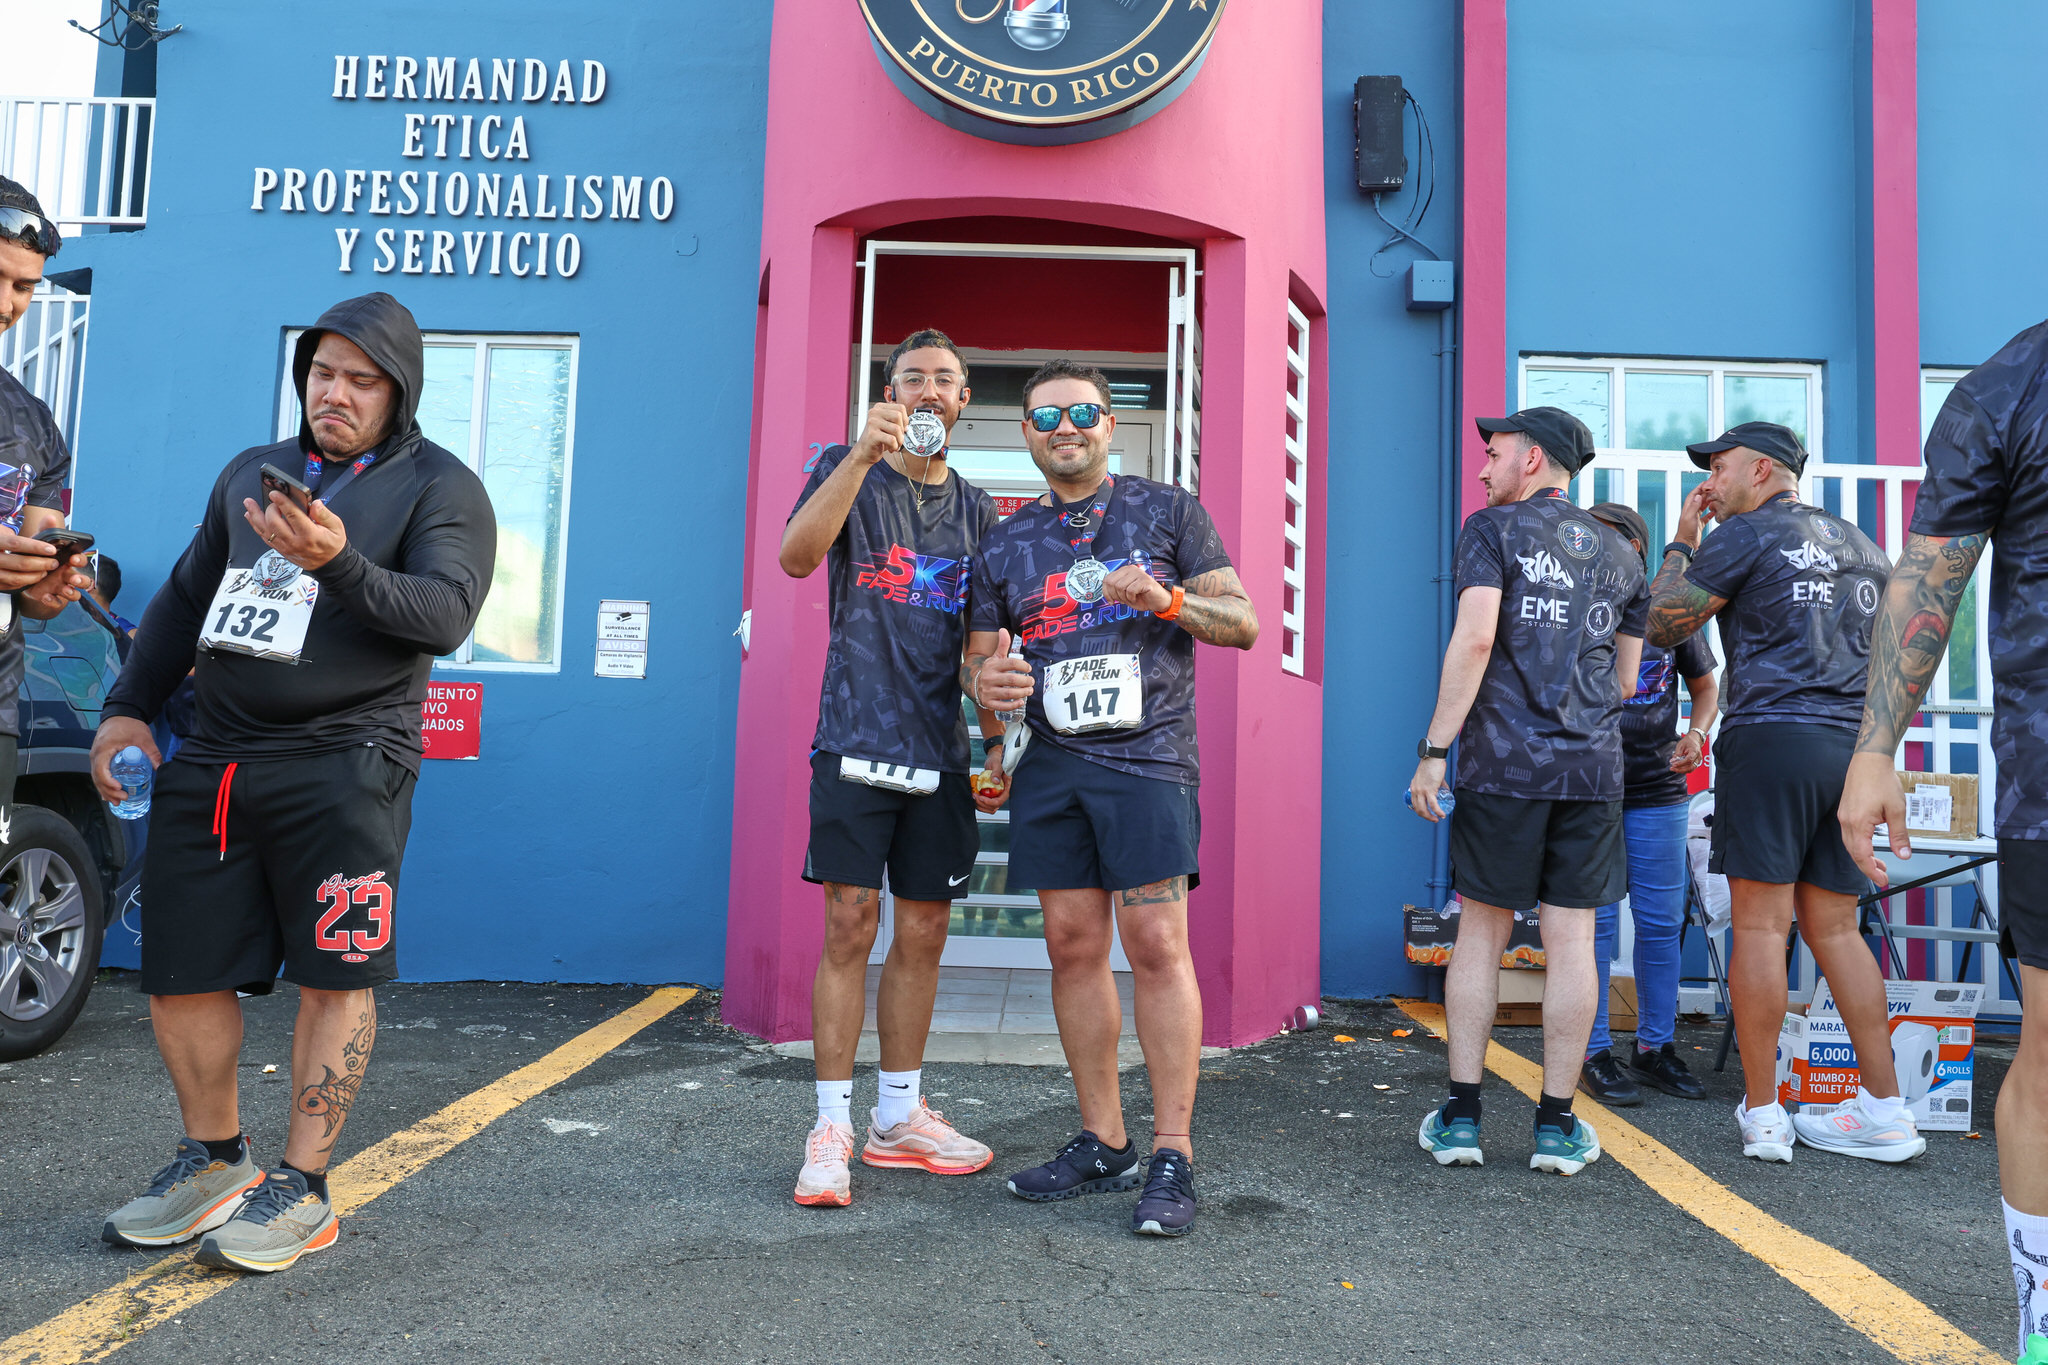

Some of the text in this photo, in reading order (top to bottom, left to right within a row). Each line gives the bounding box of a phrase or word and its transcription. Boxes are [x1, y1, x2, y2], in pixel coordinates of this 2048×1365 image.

[332, 55, 607, 103] HERMANDAD
[907, 36, 1160, 107] PUERTO RICO
[401, 113, 530, 160] ETICA
[250, 167, 675, 220] PROFESIONALISMO
[334, 228, 581, 277] Y SERVICIO
[803, 442, 839, 473] 2
[1007, 499, 1018, 507] SE
[876, 543, 959, 596] 5K
[258, 589, 294, 601] RUN
[856, 571, 910, 603] FADE
[909, 592, 924, 607] &
[1792, 581, 1835, 604] EME
[1520, 595, 1570, 623] EME
[1800, 602, 1828, 610] STUDIO
[213, 603, 280, 643] 132
[1021, 615, 1079, 646] FADE
[1080, 612, 1095, 629] &
[1528, 620, 1561, 630] STUDIO
[604, 641, 640, 650] AVISO
[1073, 658, 1108, 672] FADE
[1091, 669, 1121, 681] RUN
[421, 702, 448, 715] IVO
[1064, 687, 1121, 721] 147
[323, 870, 386, 896] Chicago
[315, 881, 393, 952] 23
[1811, 1047, 1850, 1063] 6,000
[1808, 1072, 1861, 1083] JUMBO 2-
[1936, 1063, 1971, 1077] 6 ROLLS
[1808, 1083, 1843, 1094] TOILET
